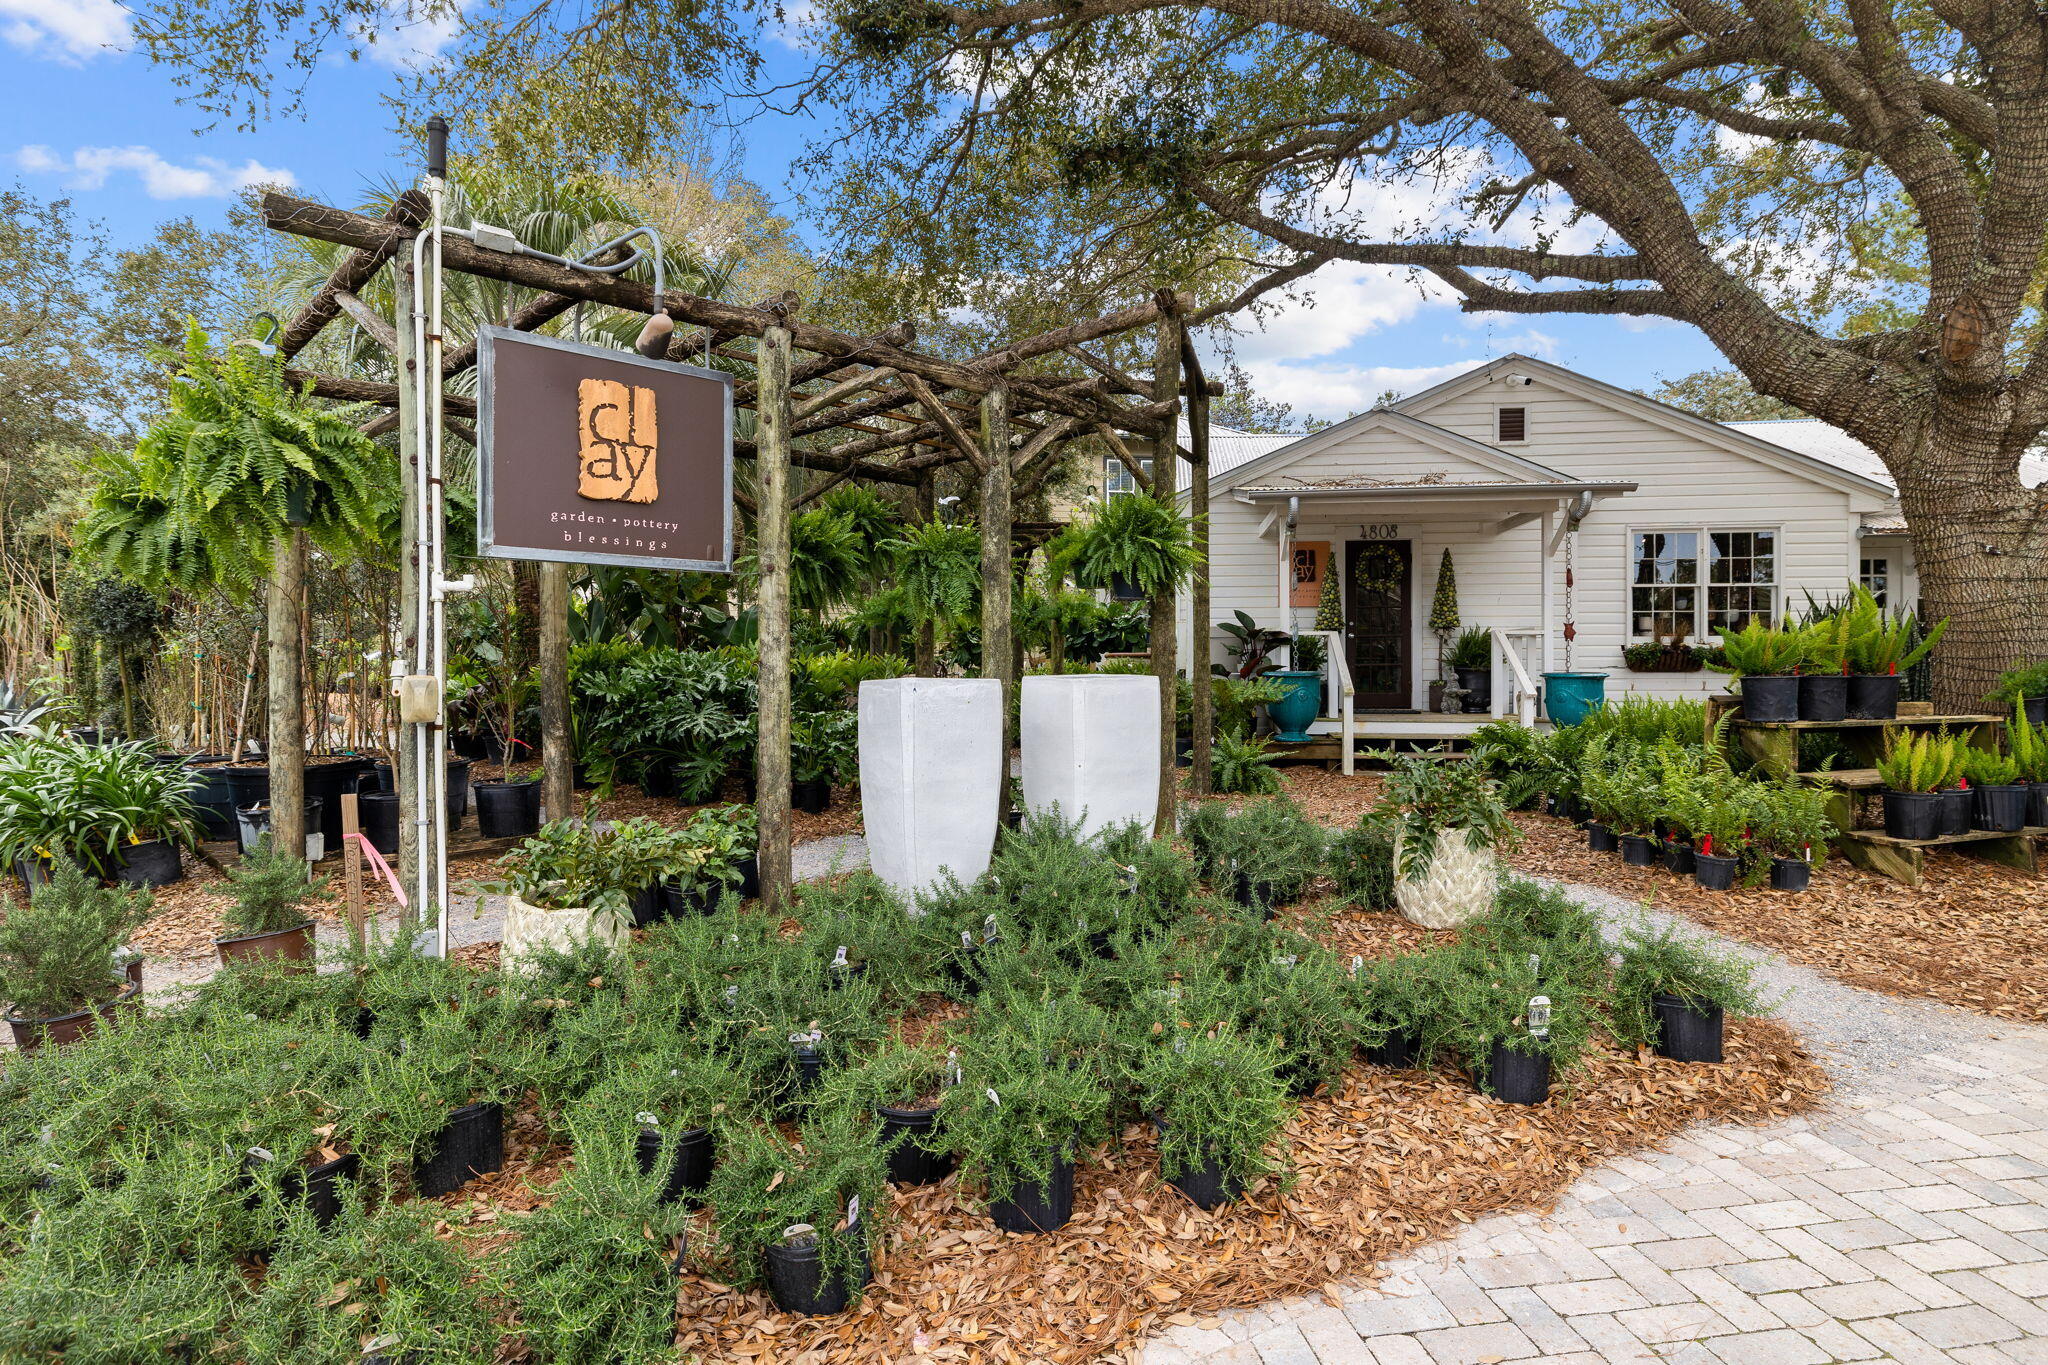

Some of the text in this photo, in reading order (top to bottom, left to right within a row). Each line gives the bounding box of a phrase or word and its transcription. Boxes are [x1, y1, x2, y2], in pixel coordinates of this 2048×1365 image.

[550, 511, 678, 532] garden pottery
[564, 530, 667, 550] blessings
[1359, 524, 1398, 540] 4808
